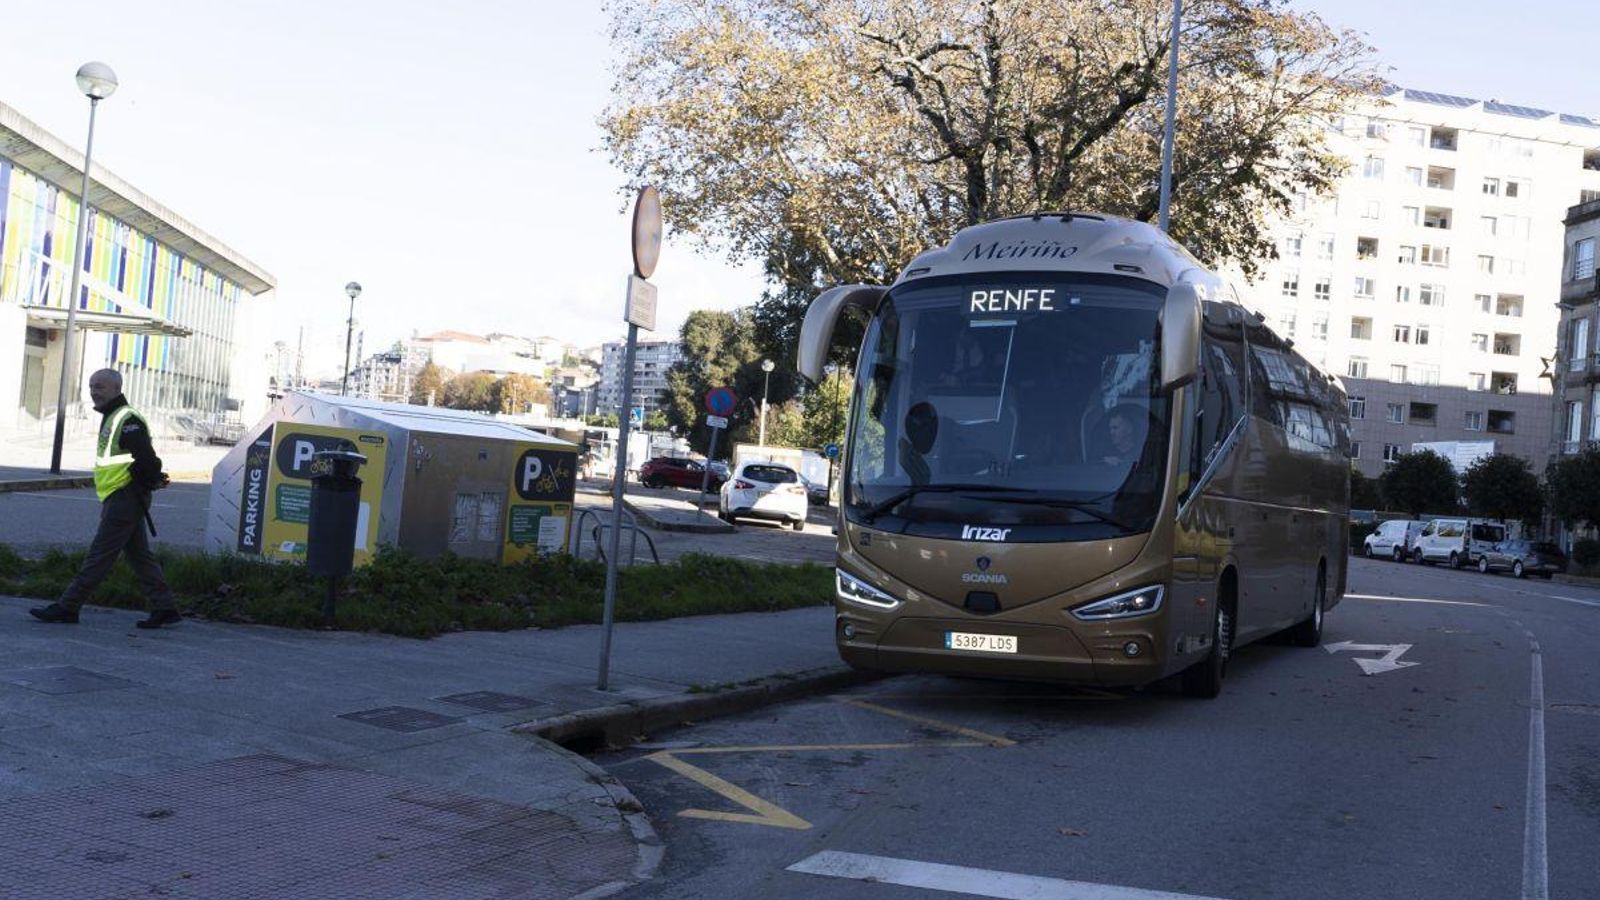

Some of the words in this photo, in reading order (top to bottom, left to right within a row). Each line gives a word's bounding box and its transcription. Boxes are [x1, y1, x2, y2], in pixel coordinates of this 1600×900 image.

[962, 240, 1079, 261] Meiriño
[970, 288, 1056, 313] RENFE
[293, 439, 315, 471] P
[522, 456, 542, 492] P
[243, 468, 262, 546] PARKING
[961, 524, 1012, 541] Irizar
[961, 572, 1007, 584] SCANIA
[955, 633, 986, 649] 5387
[989, 637, 1013, 651] LDS
